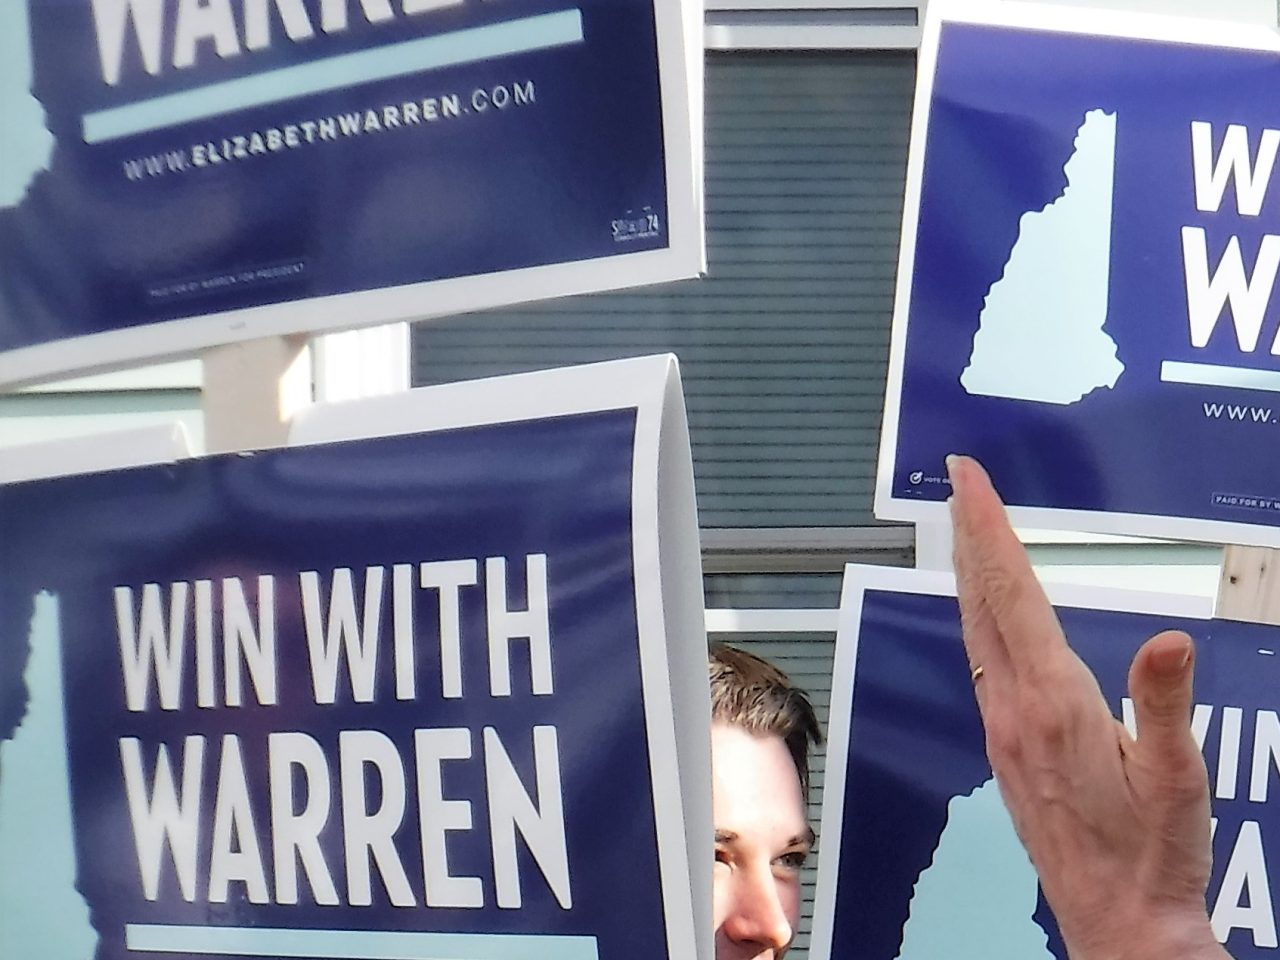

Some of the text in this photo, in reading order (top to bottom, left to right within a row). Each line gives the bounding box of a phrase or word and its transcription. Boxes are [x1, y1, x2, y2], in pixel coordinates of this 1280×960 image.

[124, 80, 536, 180] WWW.ELIZABETHWARREN.COM
[1216, 496, 1237, 505] PAID
[1239, 498, 1257, 507] FOR
[1260, 500, 1272, 508] BY
[114, 553, 555, 713] WIN WITH
[119, 725, 574, 910] WARREN
